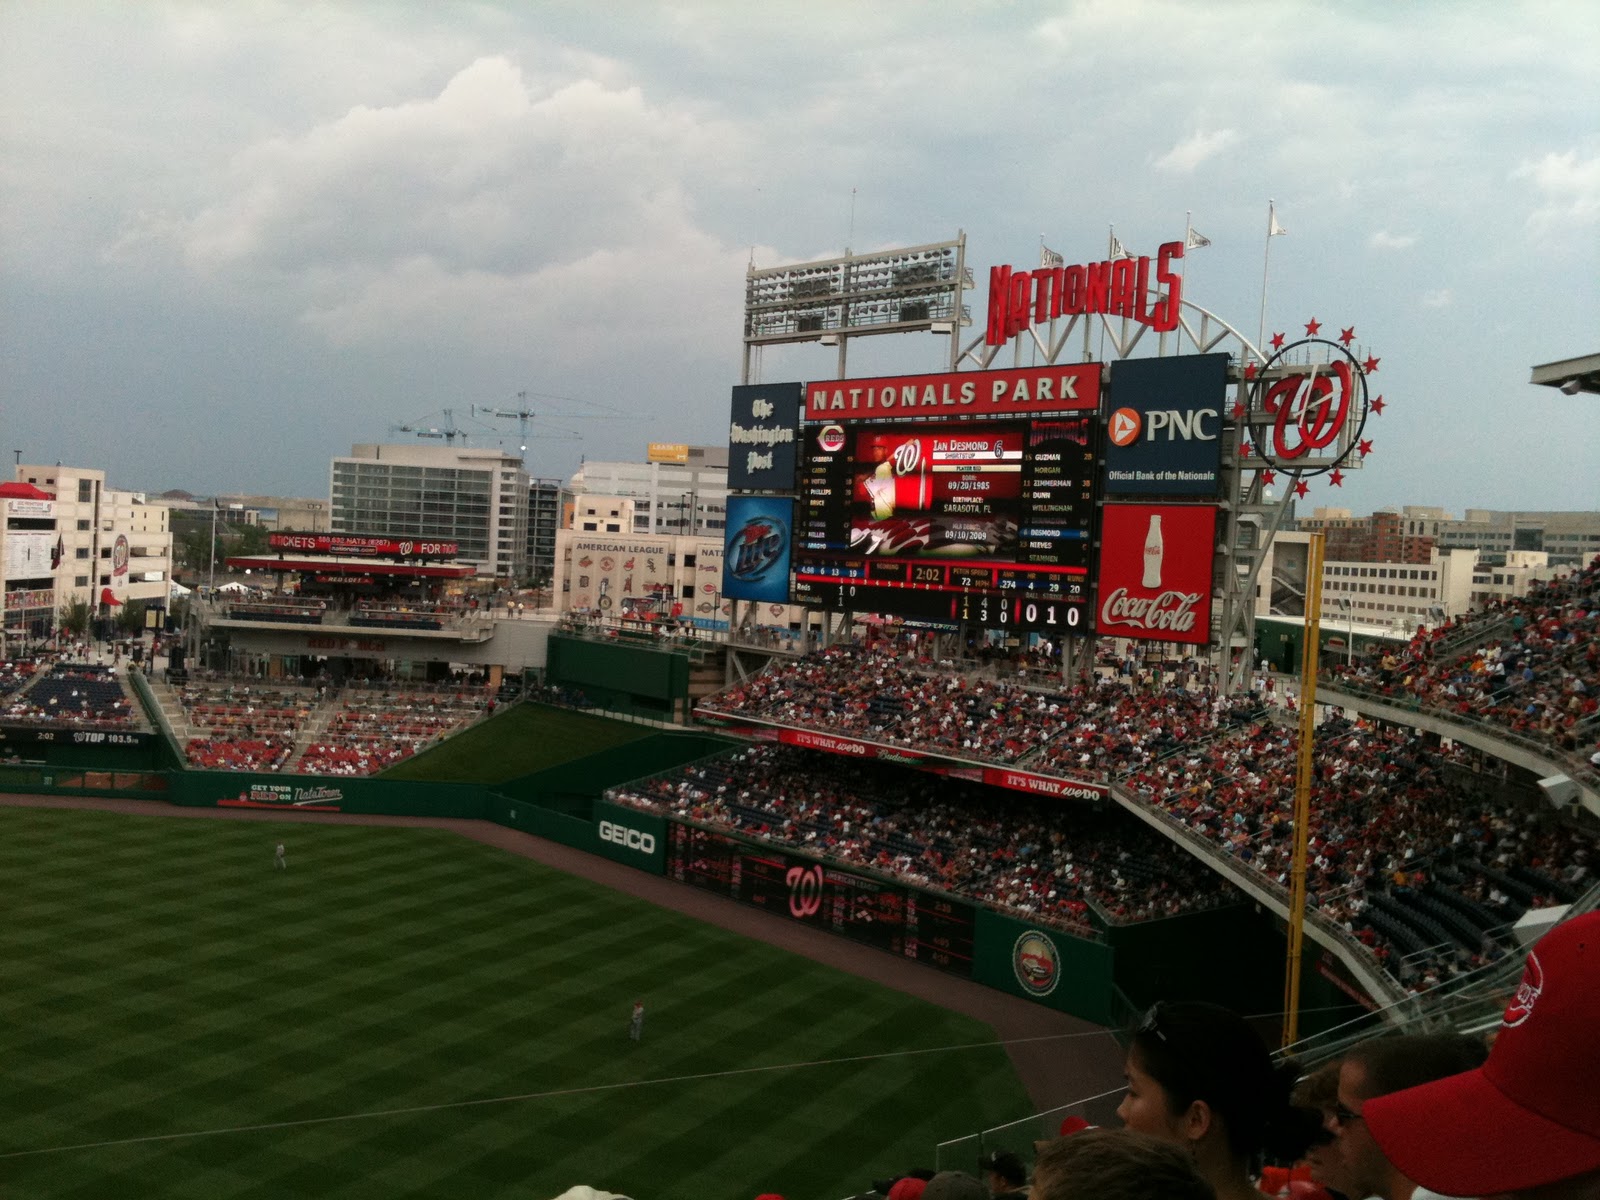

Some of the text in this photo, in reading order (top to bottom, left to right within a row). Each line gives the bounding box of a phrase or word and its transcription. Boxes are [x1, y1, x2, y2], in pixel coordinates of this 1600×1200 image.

[986, 240, 1184, 346] NATIONALS
[813, 375, 1079, 411] NATIONALS PARK
[1145, 409, 1218, 442] PNC
[730, 422, 794, 447] Washington
[950, 440, 989, 452] DESMOND
[746, 451, 774, 475] Post
[1034, 454, 1061, 462] GUZMAN
[1034, 467, 1061, 475] MORGAN
[1109, 471, 1215, 481] Official Bank of the Nationals
[948, 481, 990, 491] 09/20/1985
[1033, 480, 1072, 488] ZIMMERMAN
[1032, 492, 1051, 500] DUNN
[1031, 504, 1073, 513] WILLINGHAM
[945, 530, 987, 541] 09/10/2009
[1030, 529, 1062, 538] DESMOND
[421, 543, 440, 555] FOR
[576, 543, 664, 555] AMERICAN LEAGUE
[831, 568, 840, 577] 13
[849, 569, 858, 578] 19
[915, 568, 940, 582] 2:02
[961, 577, 971, 587] 72
[1027, 581, 1035, 591] 4
[1049, 583, 1060, 593] 29
[1069, 585, 1081, 595] 20
[838, 586, 844, 596] 1
[849, 586, 856, 597] 0
[838, 597, 844, 607] 1
[963, 596, 1008, 610] 1 4 0
[1025, 604, 1079, 627] 0 1 0
[1102, 587, 1203, 632] Coca-Cola
[962, 608, 1007, 624] 1 3 0
[108, 733, 132, 744] 103.5
[796, 733, 811, 745] IT'S
[812, 735, 836, 749] WHAT
[852, 743, 865, 755] DO
[251, 784, 292, 793] GET YOUR
[1007, 775, 1026, 788] IT'S
[1029, 778, 1061, 794] WHAT
[1083, 789, 1100, 802] DO
[250, 790, 292, 801] RED ON
[599, 820, 656, 854] GEICO
